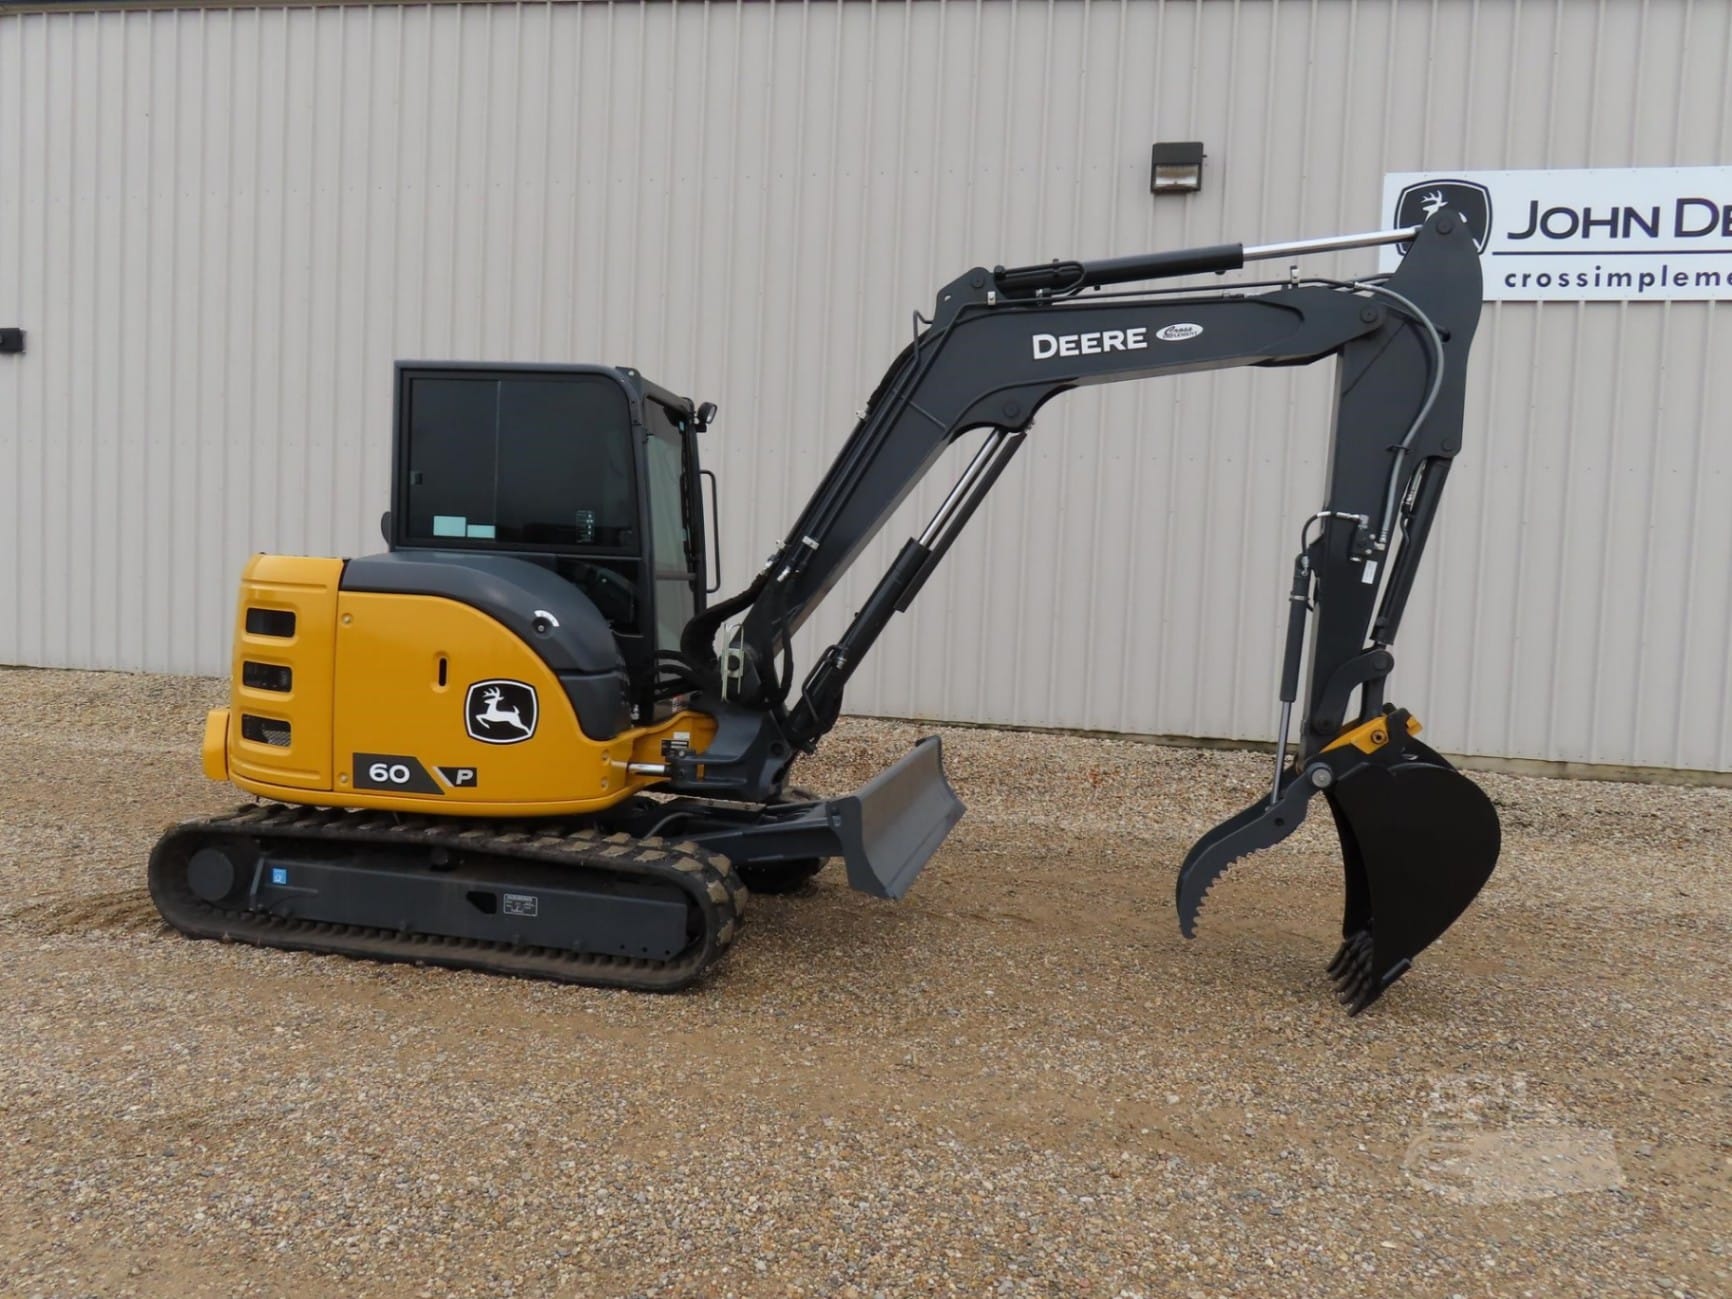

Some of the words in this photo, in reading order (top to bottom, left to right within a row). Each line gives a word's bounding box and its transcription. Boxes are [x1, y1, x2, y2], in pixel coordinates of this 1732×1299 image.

[1507, 199, 1661, 240] JOHN
[1032, 327, 1148, 360] DEERE
[369, 763, 410, 784] 60
[456, 769, 474, 785] P
